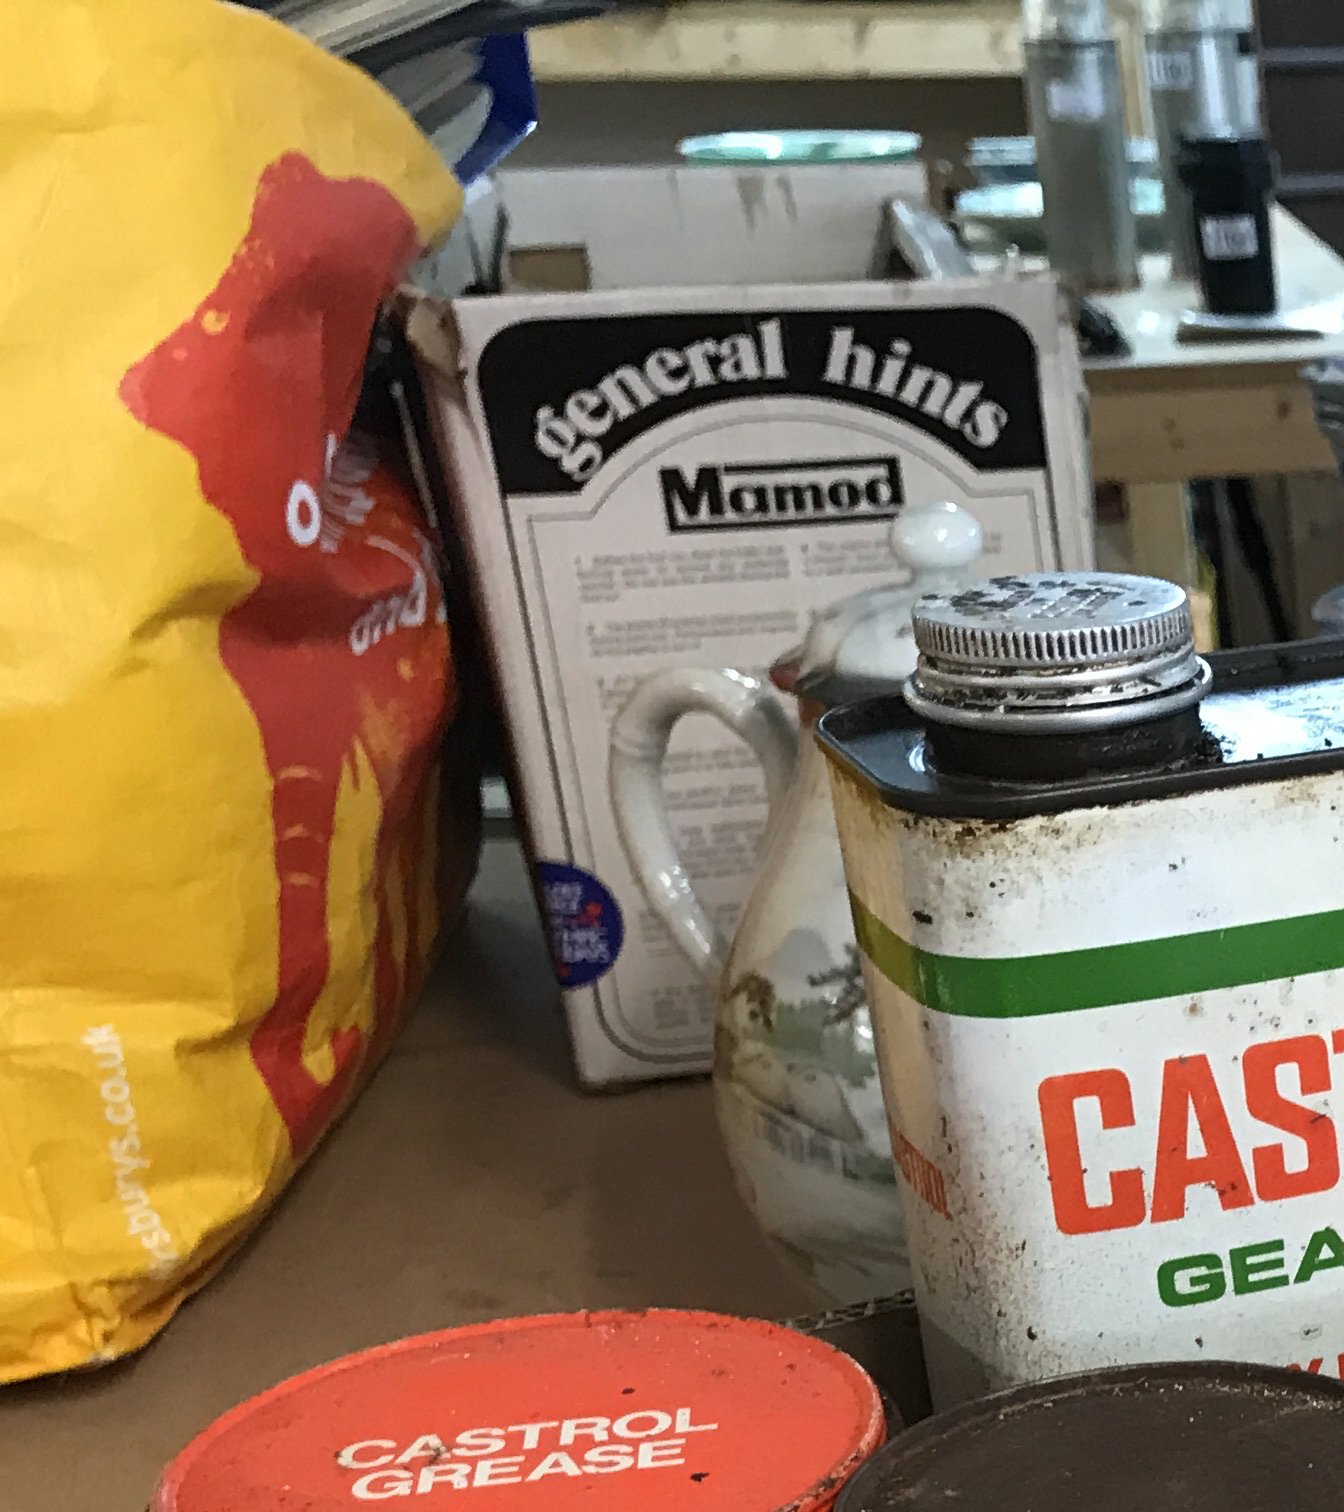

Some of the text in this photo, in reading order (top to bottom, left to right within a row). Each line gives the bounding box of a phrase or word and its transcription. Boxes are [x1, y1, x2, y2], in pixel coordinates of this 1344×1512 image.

[535, 317, 1010, 481] general hints
[661, 456, 904, 532] Mamod
[337, 1407, 719, 1471] CASTROL
[351, 1439, 687, 1501] GREASE
